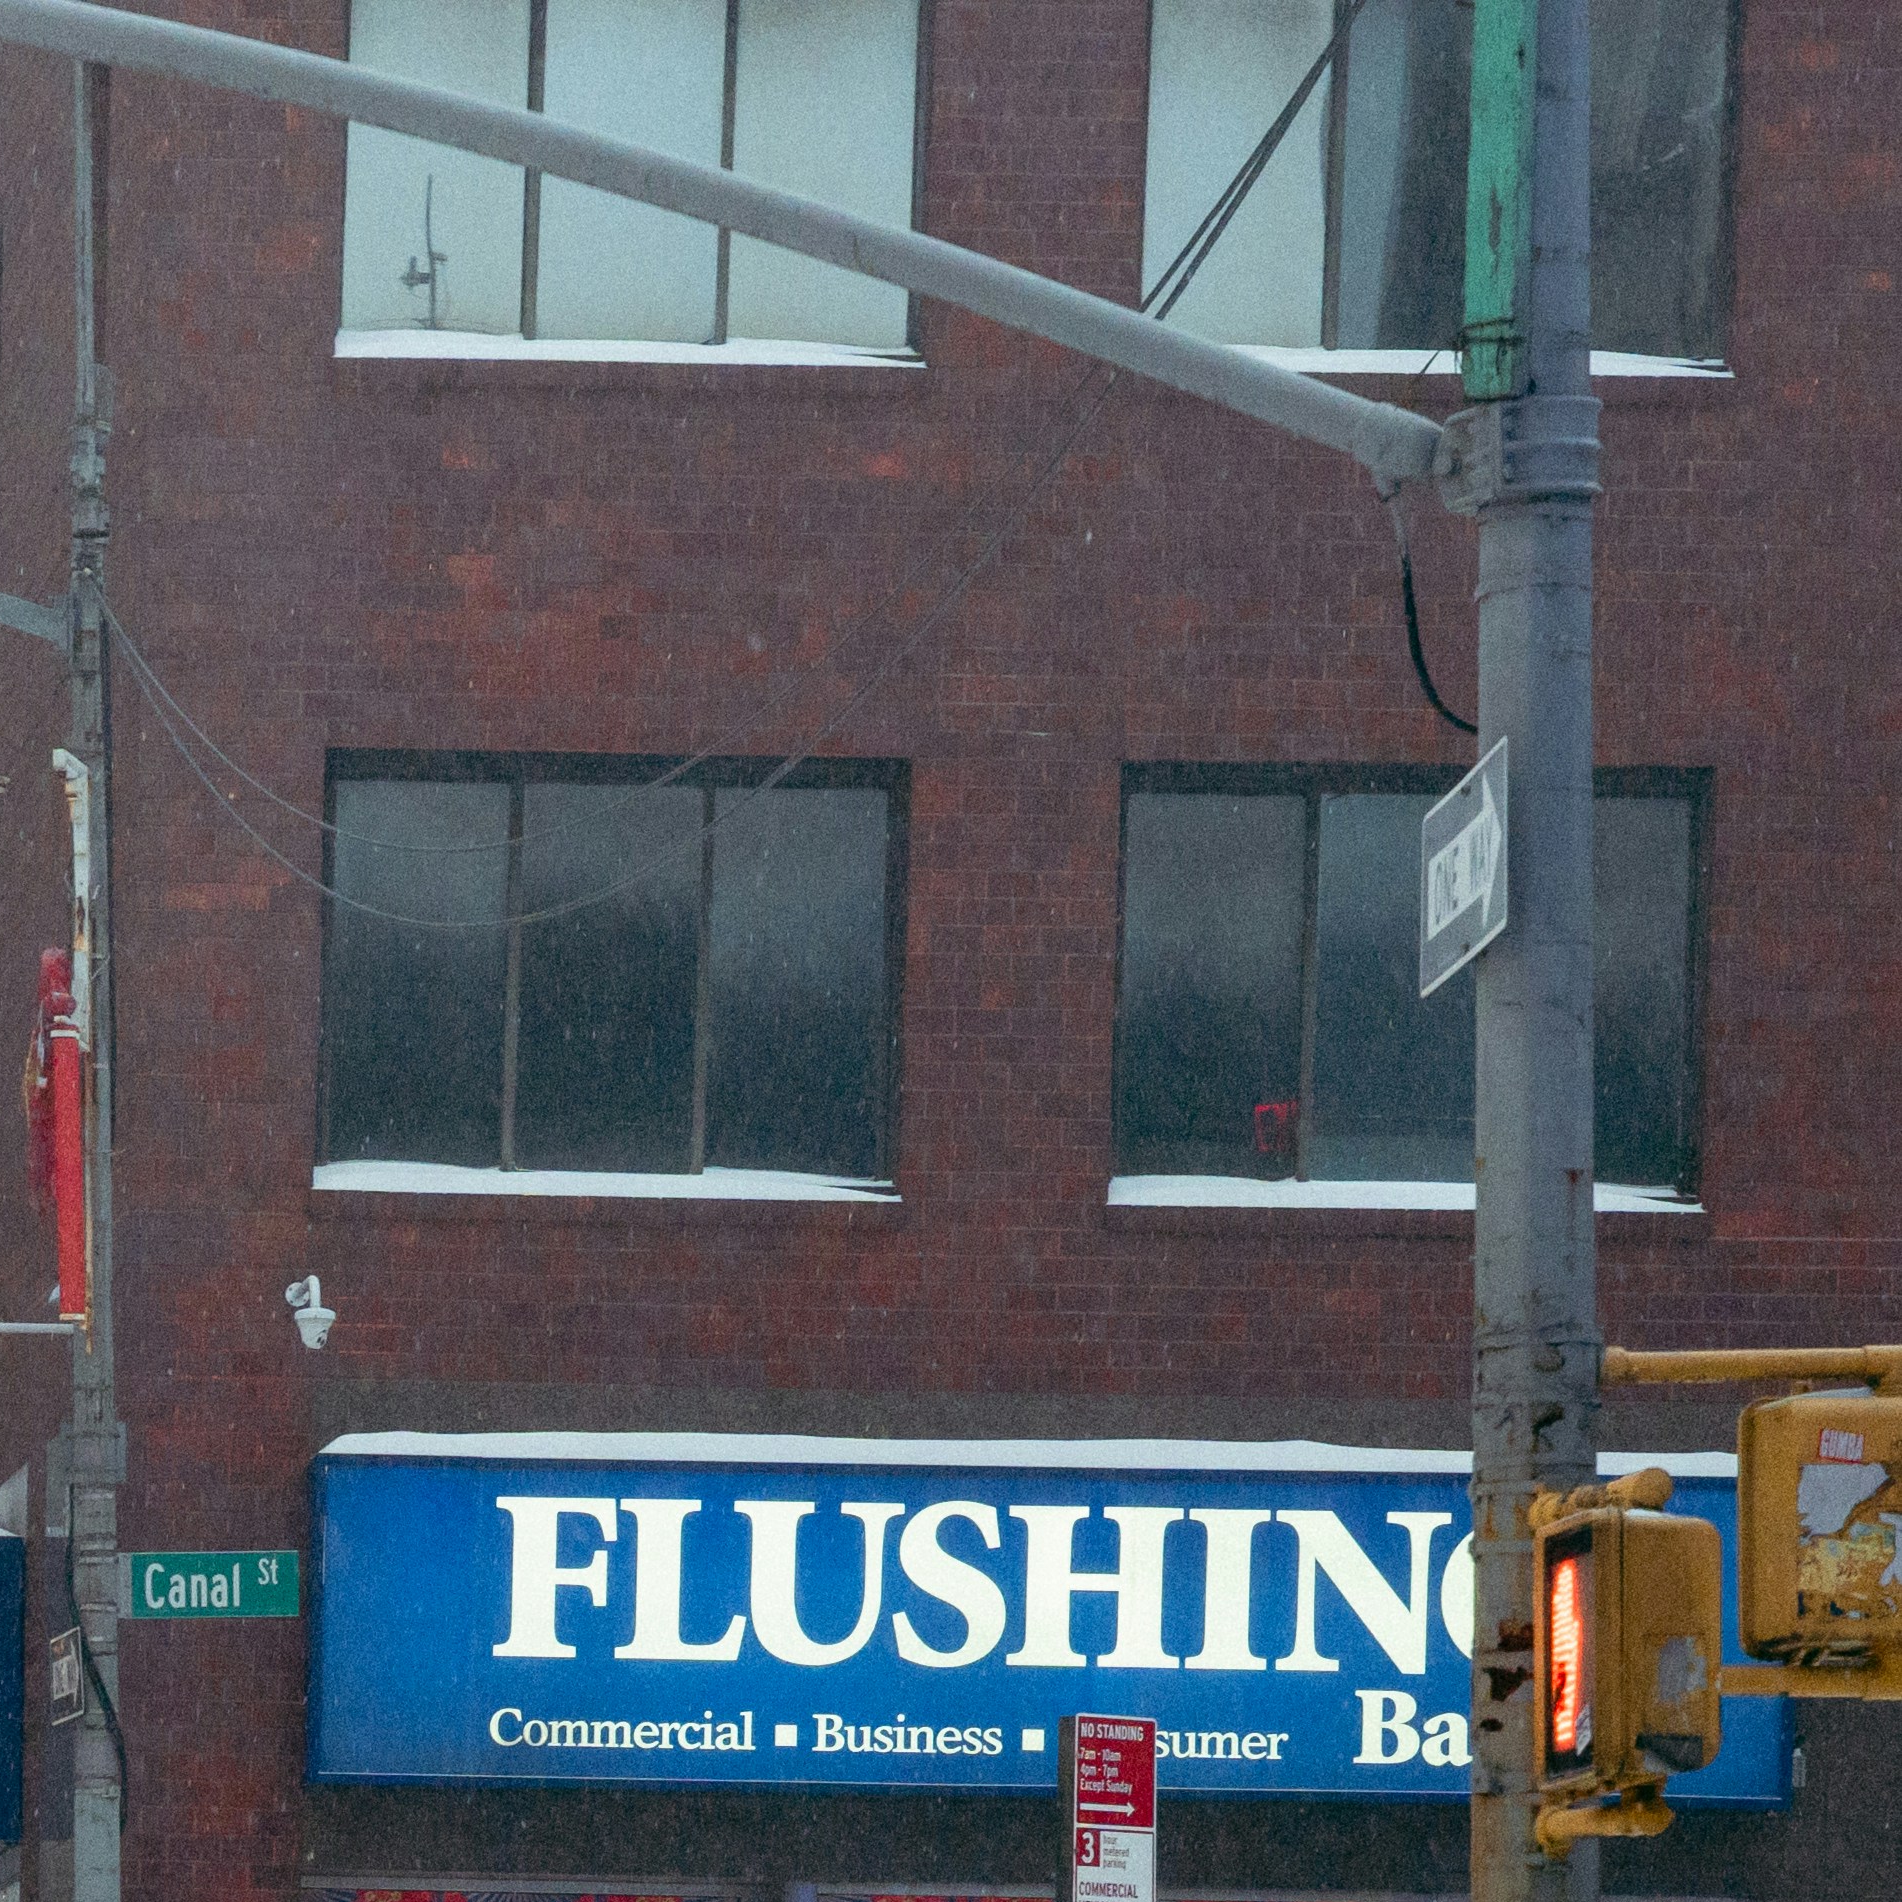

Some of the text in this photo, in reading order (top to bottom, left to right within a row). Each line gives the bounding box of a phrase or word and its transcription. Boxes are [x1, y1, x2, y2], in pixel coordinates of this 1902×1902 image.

[145, 1557, 278, 1609] Canal St
[489, 1708, 1288, 1761] Commercial Business sumer
[1080, 1722, 1144, 1741] NO STANDING
[1353, 1689, 1474, 1768] Ba
[1079, 1747, 1096, 1761] 7am
[1102, 1749, 1121, 1762] 10am
[1080, 1765, 1096, 1778] 4pm
[1102, 1766, 1119, 1779] 7pm
[1080, 1778, 1133, 1795] Except Sunday
[1081, 1832, 1095, 1864] 3
[1103, 1847, 1130, 1858] metered
[1102, 1858, 1126, 1870] parking
[1079, 1881, 1139, 1899] COMMERCIAL
